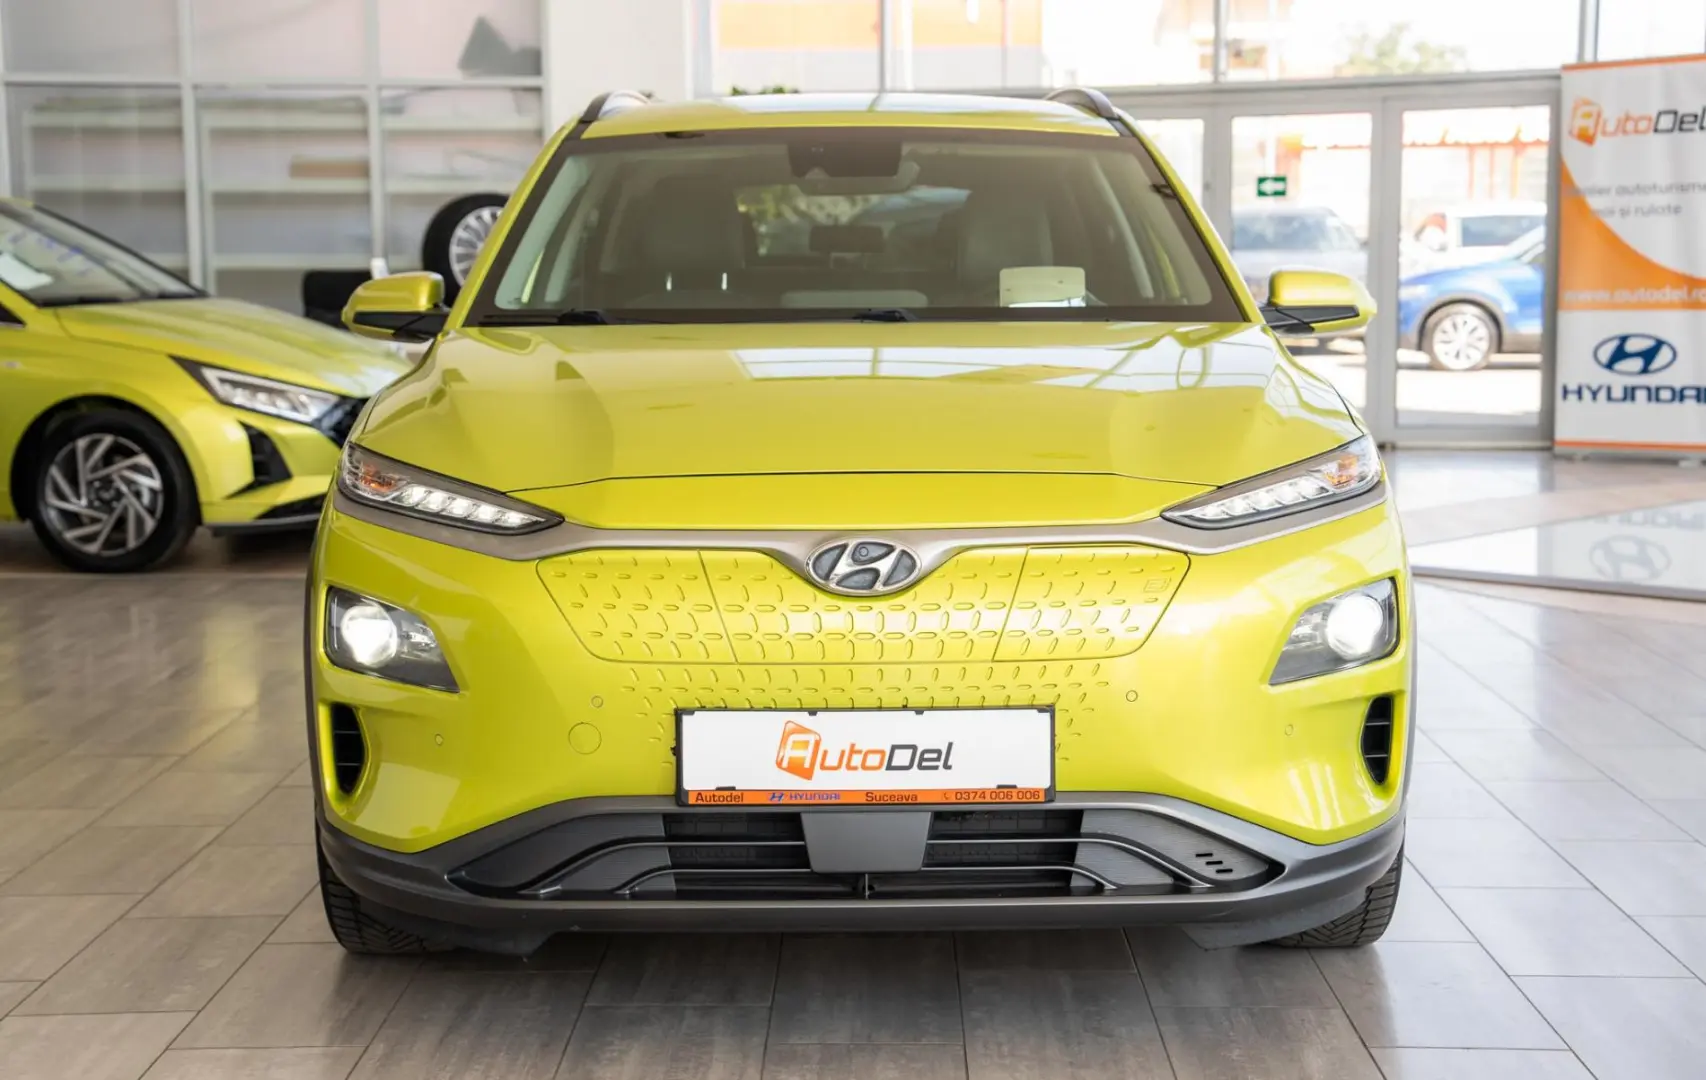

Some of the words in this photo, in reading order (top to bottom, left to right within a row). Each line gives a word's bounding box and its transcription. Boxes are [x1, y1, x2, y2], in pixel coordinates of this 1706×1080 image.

[1570, 98, 1706, 145] AutoDel
[776, 722, 954, 779] AutoDel
[695, 792, 744, 803] Autodel
[789, 792, 841, 801] HYUNDAI
[865, 791, 918, 802] Suceava
[955, 790, 986, 801] 0374
[989, 790, 1013, 800] 006
[1016, 790, 1041, 800] 006
